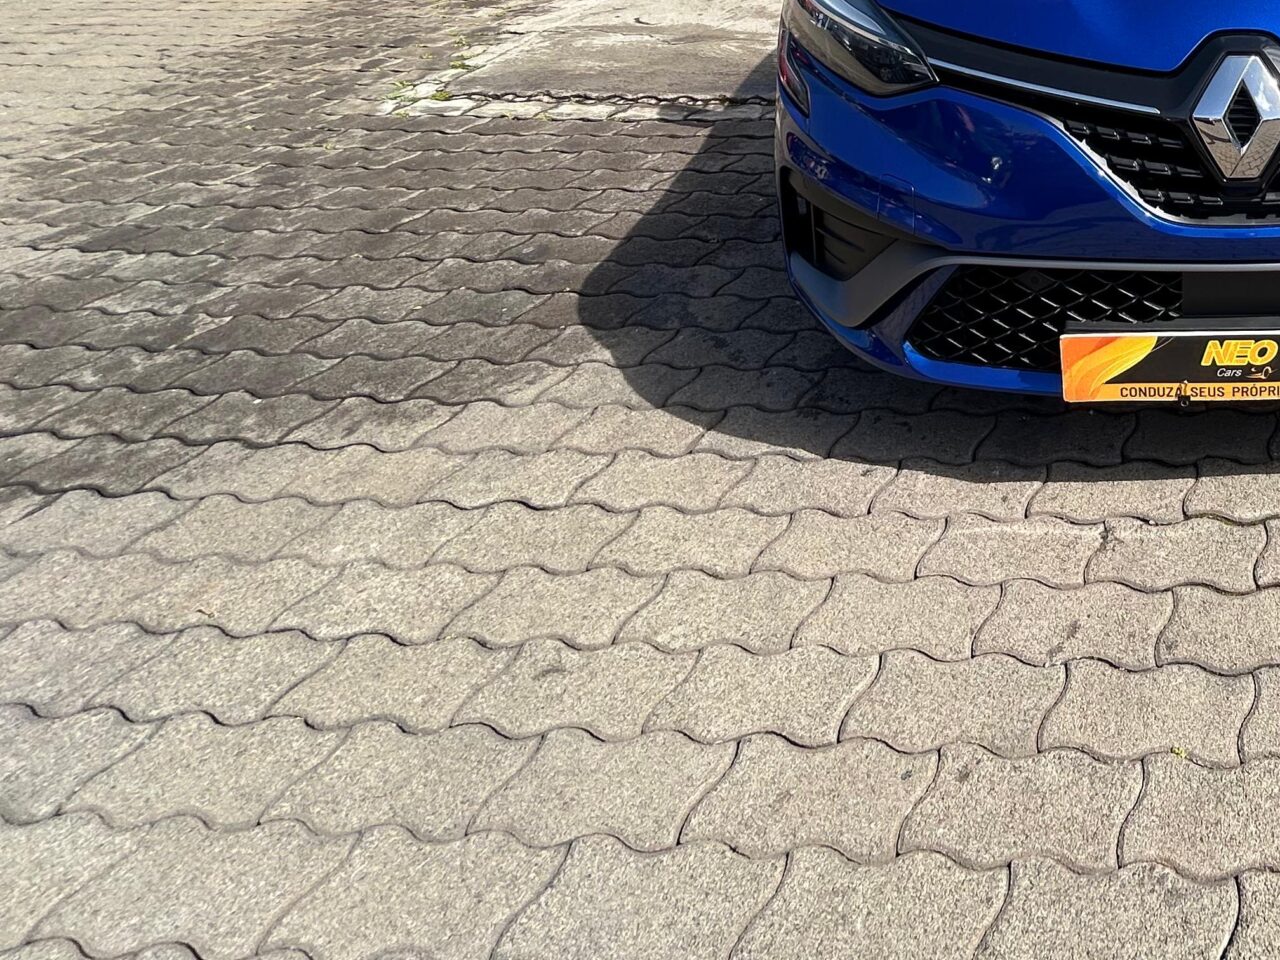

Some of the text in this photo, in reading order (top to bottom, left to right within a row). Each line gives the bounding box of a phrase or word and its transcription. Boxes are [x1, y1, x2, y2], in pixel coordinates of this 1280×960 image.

[1200, 339, 1279, 366] NEO
[1216, 367, 1242, 377] Cars
[1190, 386, 1225, 398] SEUS
